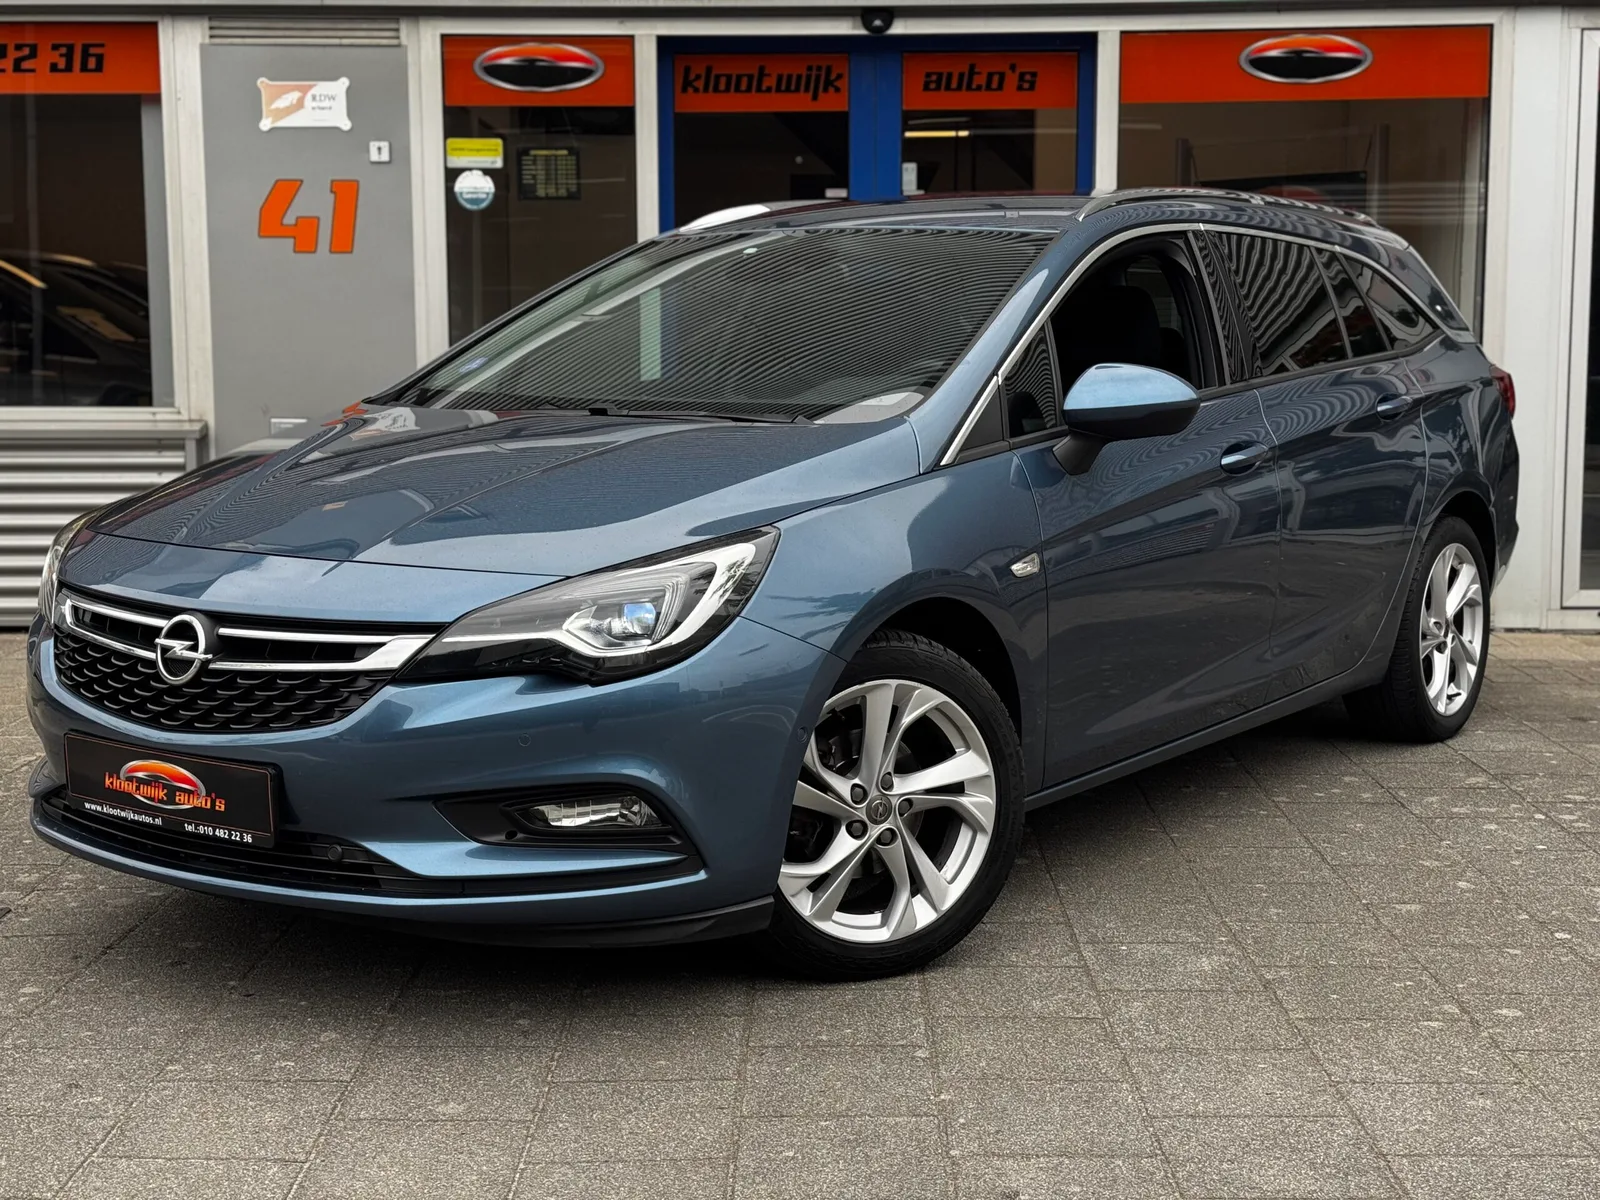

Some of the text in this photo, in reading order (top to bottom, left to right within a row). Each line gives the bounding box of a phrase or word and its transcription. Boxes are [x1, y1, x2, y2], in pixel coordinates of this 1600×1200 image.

[49, 43, 105, 73] 36
[681, 63, 1038, 101] klootwijk auto's
[258, 179, 359, 253] 41
[104, 772, 225, 812] klootwijk auto's
[84, 800, 162, 826] www.klootwijkautos.nl
[184, 822, 252, 843] tel.:010 482 22 36
